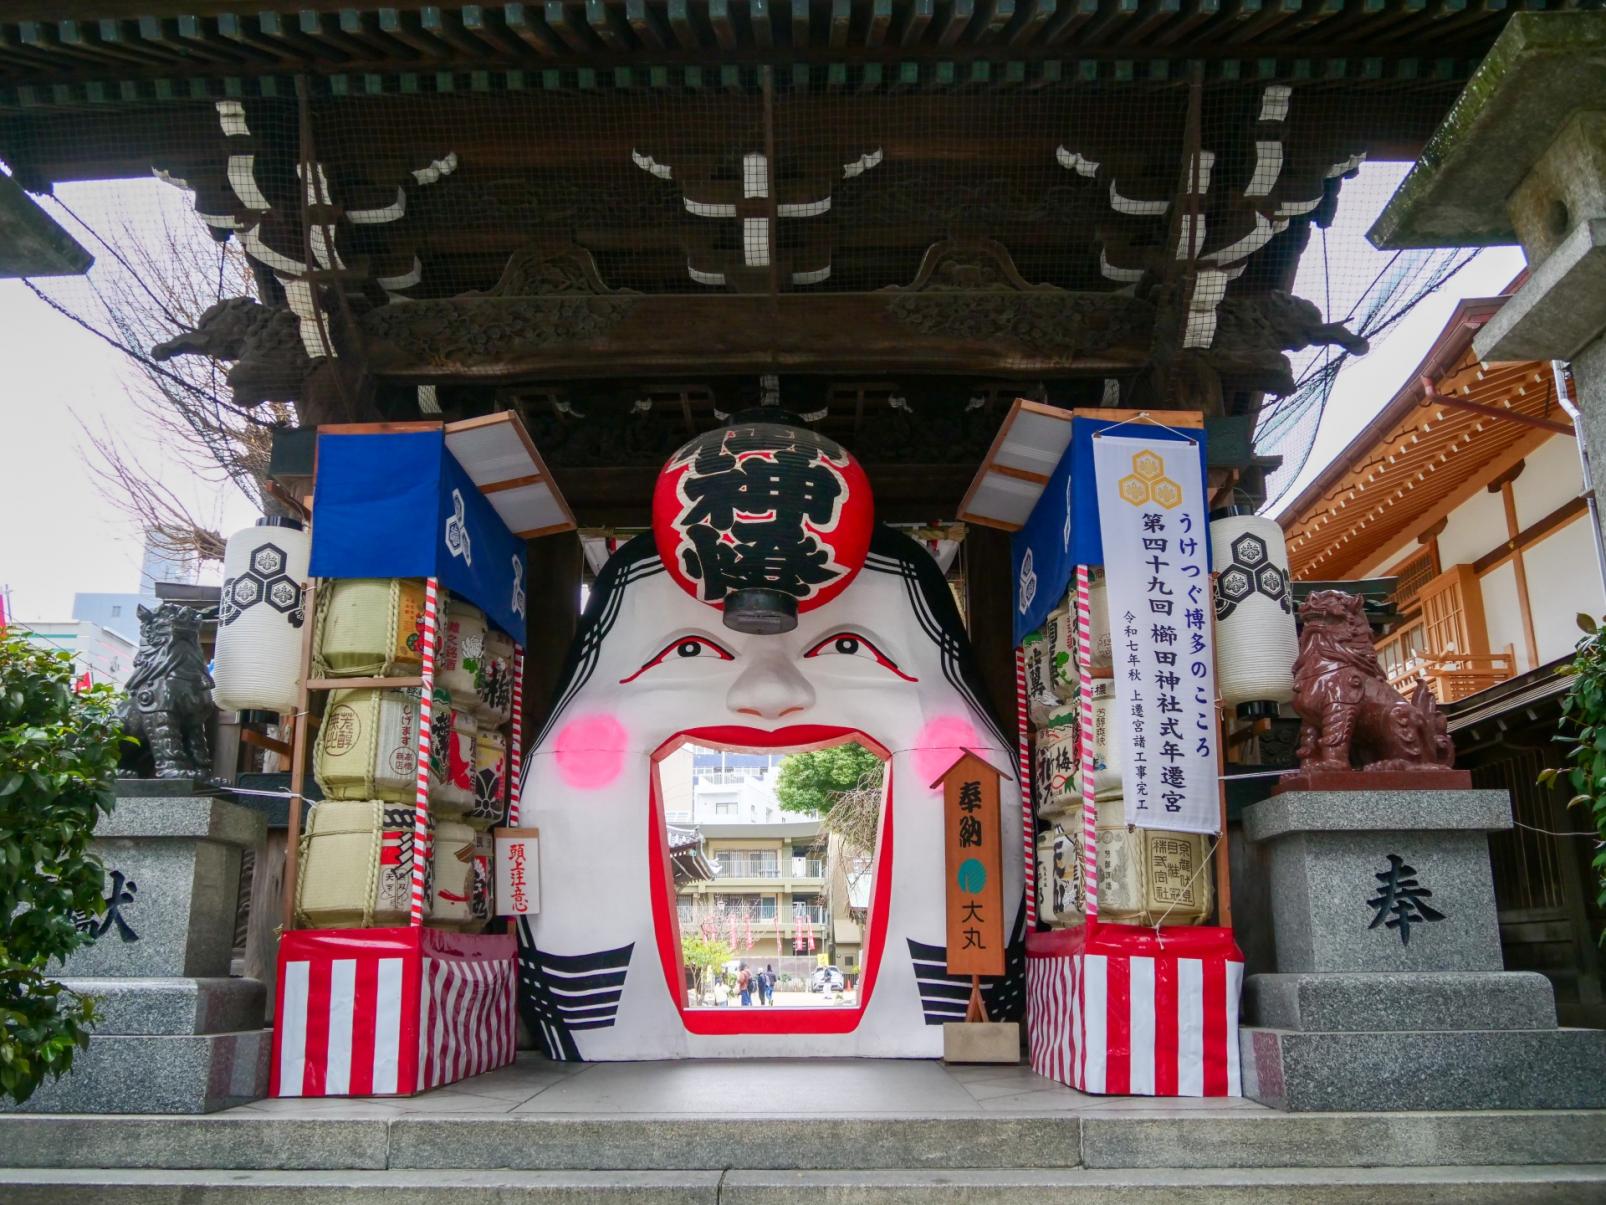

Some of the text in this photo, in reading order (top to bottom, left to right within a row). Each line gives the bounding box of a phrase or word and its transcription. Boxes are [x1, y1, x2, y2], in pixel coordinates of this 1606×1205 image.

[1123, 610, 1142, 682] 令和七年秋
[1179, 513, 1210, 757] うけつぐ博多のこころ
[401, 704, 412, 746] しげます
[507, 843, 529, 913] 頭上注意
[959, 781, 986, 950] 奉納 大丸
